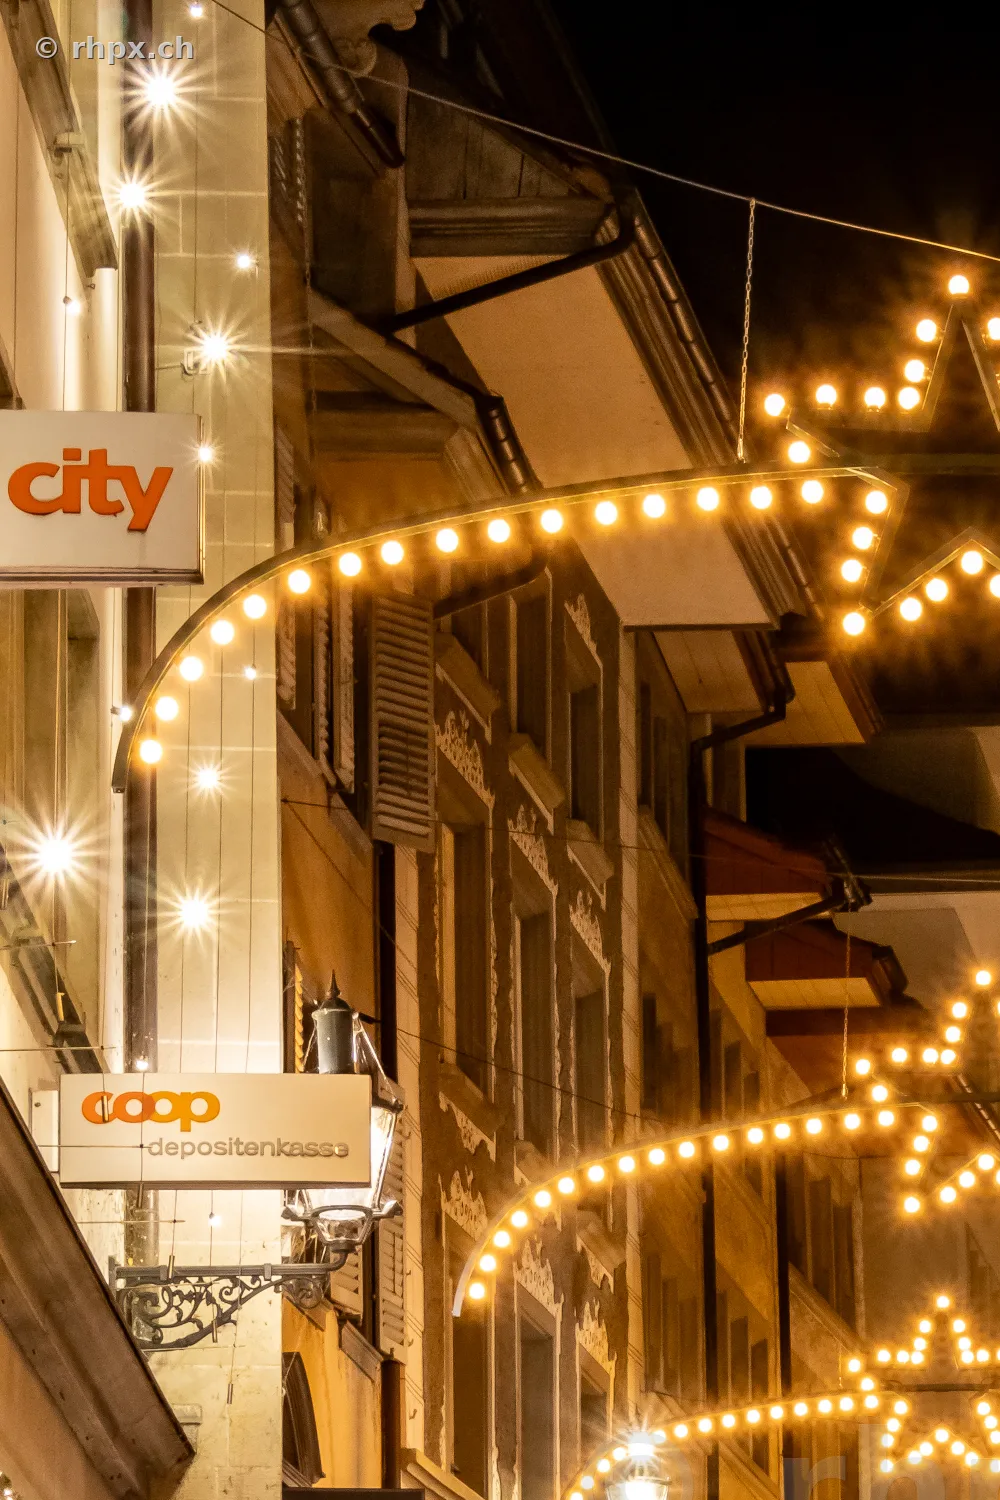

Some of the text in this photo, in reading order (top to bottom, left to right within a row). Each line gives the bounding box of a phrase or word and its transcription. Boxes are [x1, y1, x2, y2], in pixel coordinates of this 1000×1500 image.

[8, 448, 173, 532] city
[82, 1091, 220, 1132] coop
[148, 1137, 349, 1160] depositenkasse
